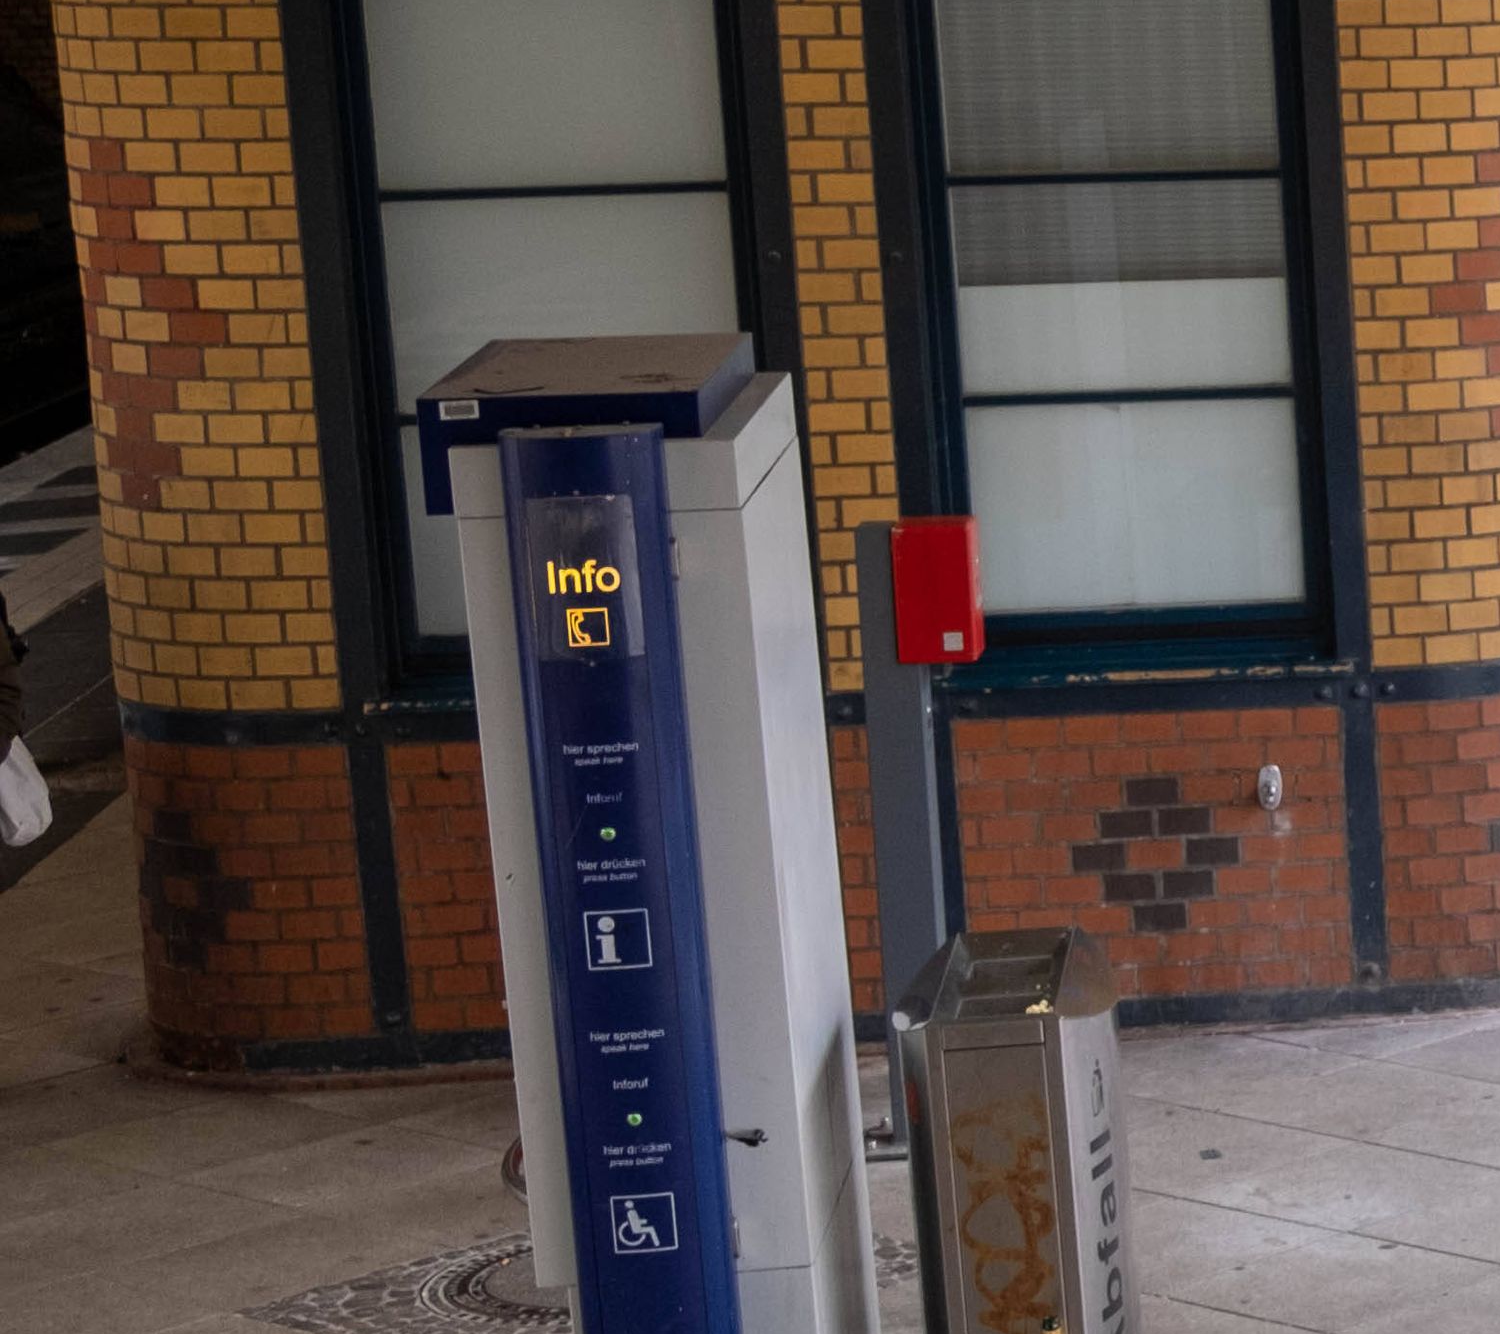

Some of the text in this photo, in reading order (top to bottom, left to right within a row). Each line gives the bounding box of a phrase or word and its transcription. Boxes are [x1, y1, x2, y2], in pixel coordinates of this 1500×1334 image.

[546, 559, 621, 595] Info
[562, 741, 639, 756] hier sprechen
[577, 857, 647, 871] hier drücken
[590, 1028, 665, 1043] hier sprechen
[613, 1076, 649, 1091] Inforuf
[603, 1145, 624, 1156] hier
